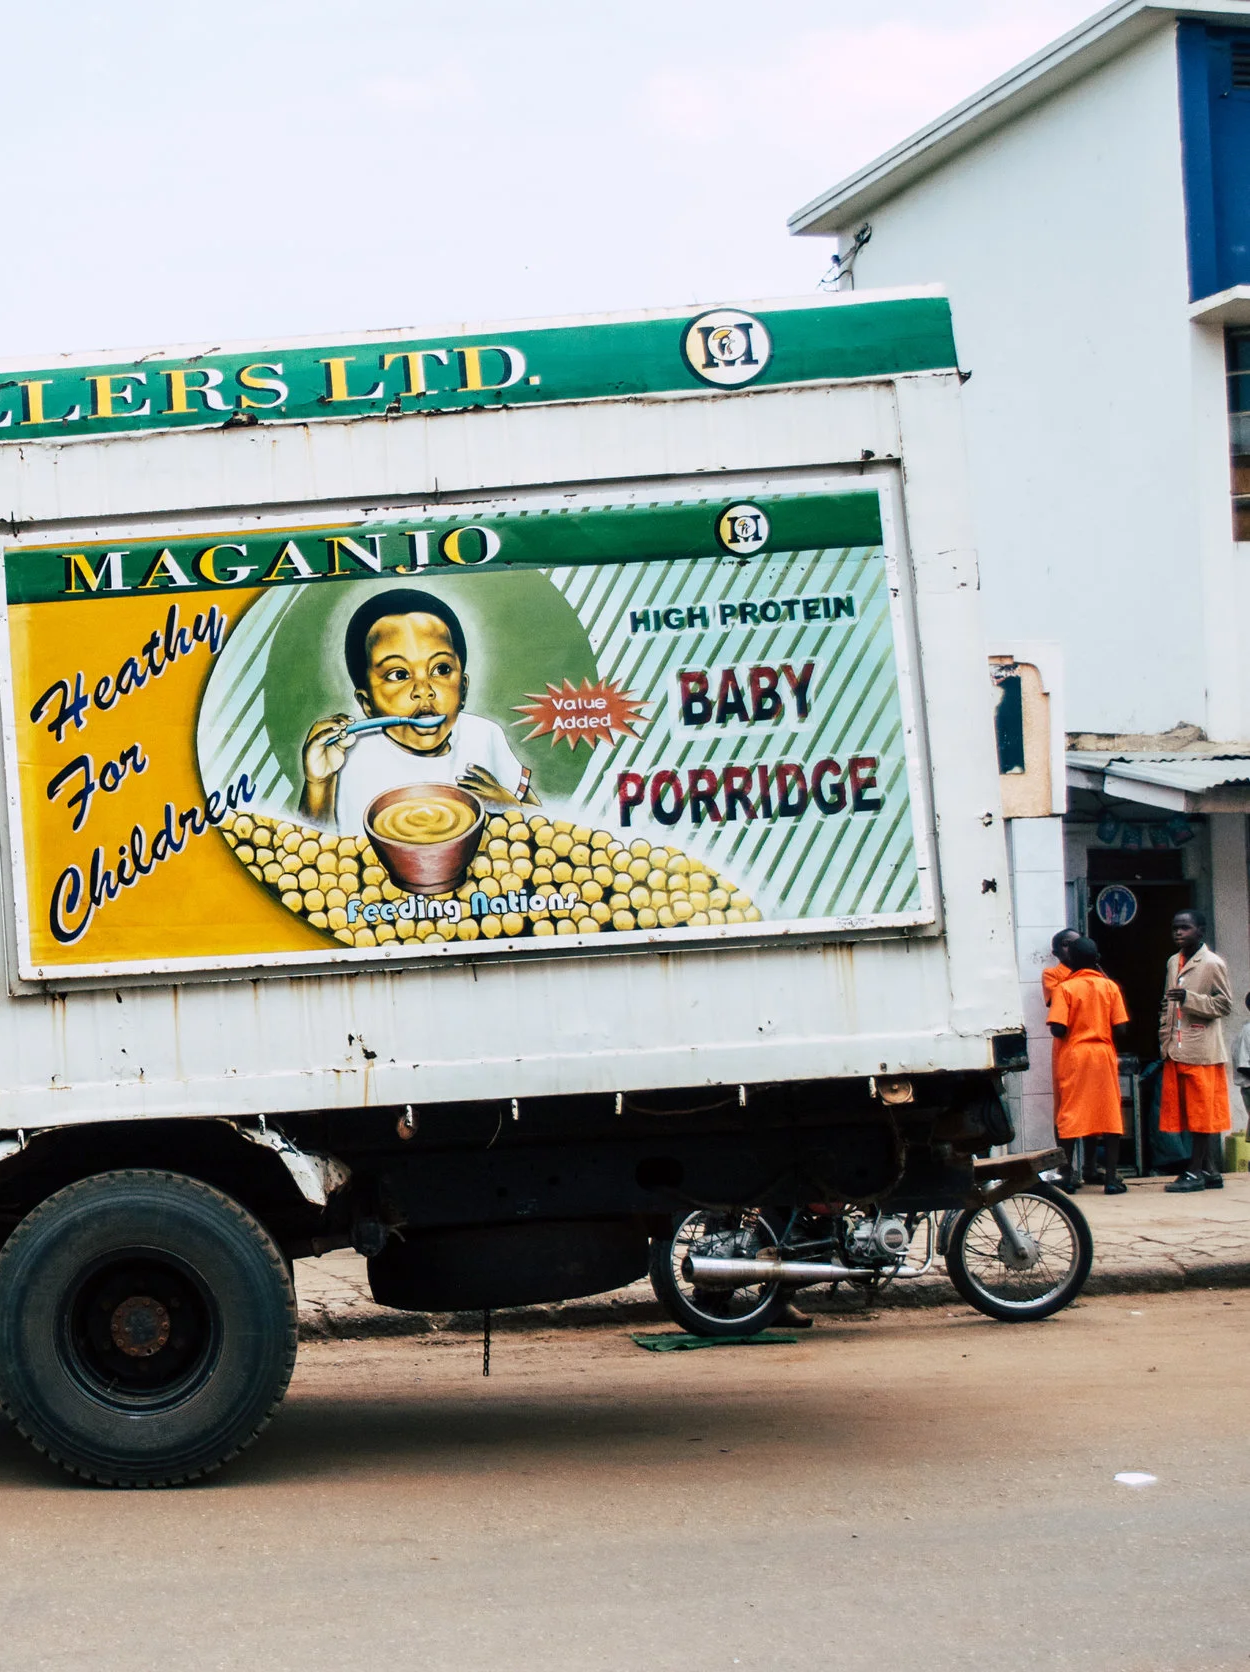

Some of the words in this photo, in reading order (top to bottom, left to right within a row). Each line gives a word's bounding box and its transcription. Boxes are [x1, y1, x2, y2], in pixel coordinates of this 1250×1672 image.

[319, 346, 540, 403] LTD.
[62, 526, 501, 594] MAGANJO
[629, 605, 709, 633] HIGH
[719, 595, 856, 626] PROTEIN
[30, 602, 228, 743] Heathy
[551, 695, 608, 711] Value
[678, 663, 816, 727] BABY
[552, 713, 612, 730] Added
[46, 739, 149, 833] For
[617, 756, 882, 828] PORRIDGE
[49, 768, 257, 945] Children
[346, 893, 461, 924] Feeding
[469, 890, 579, 917] Nations
